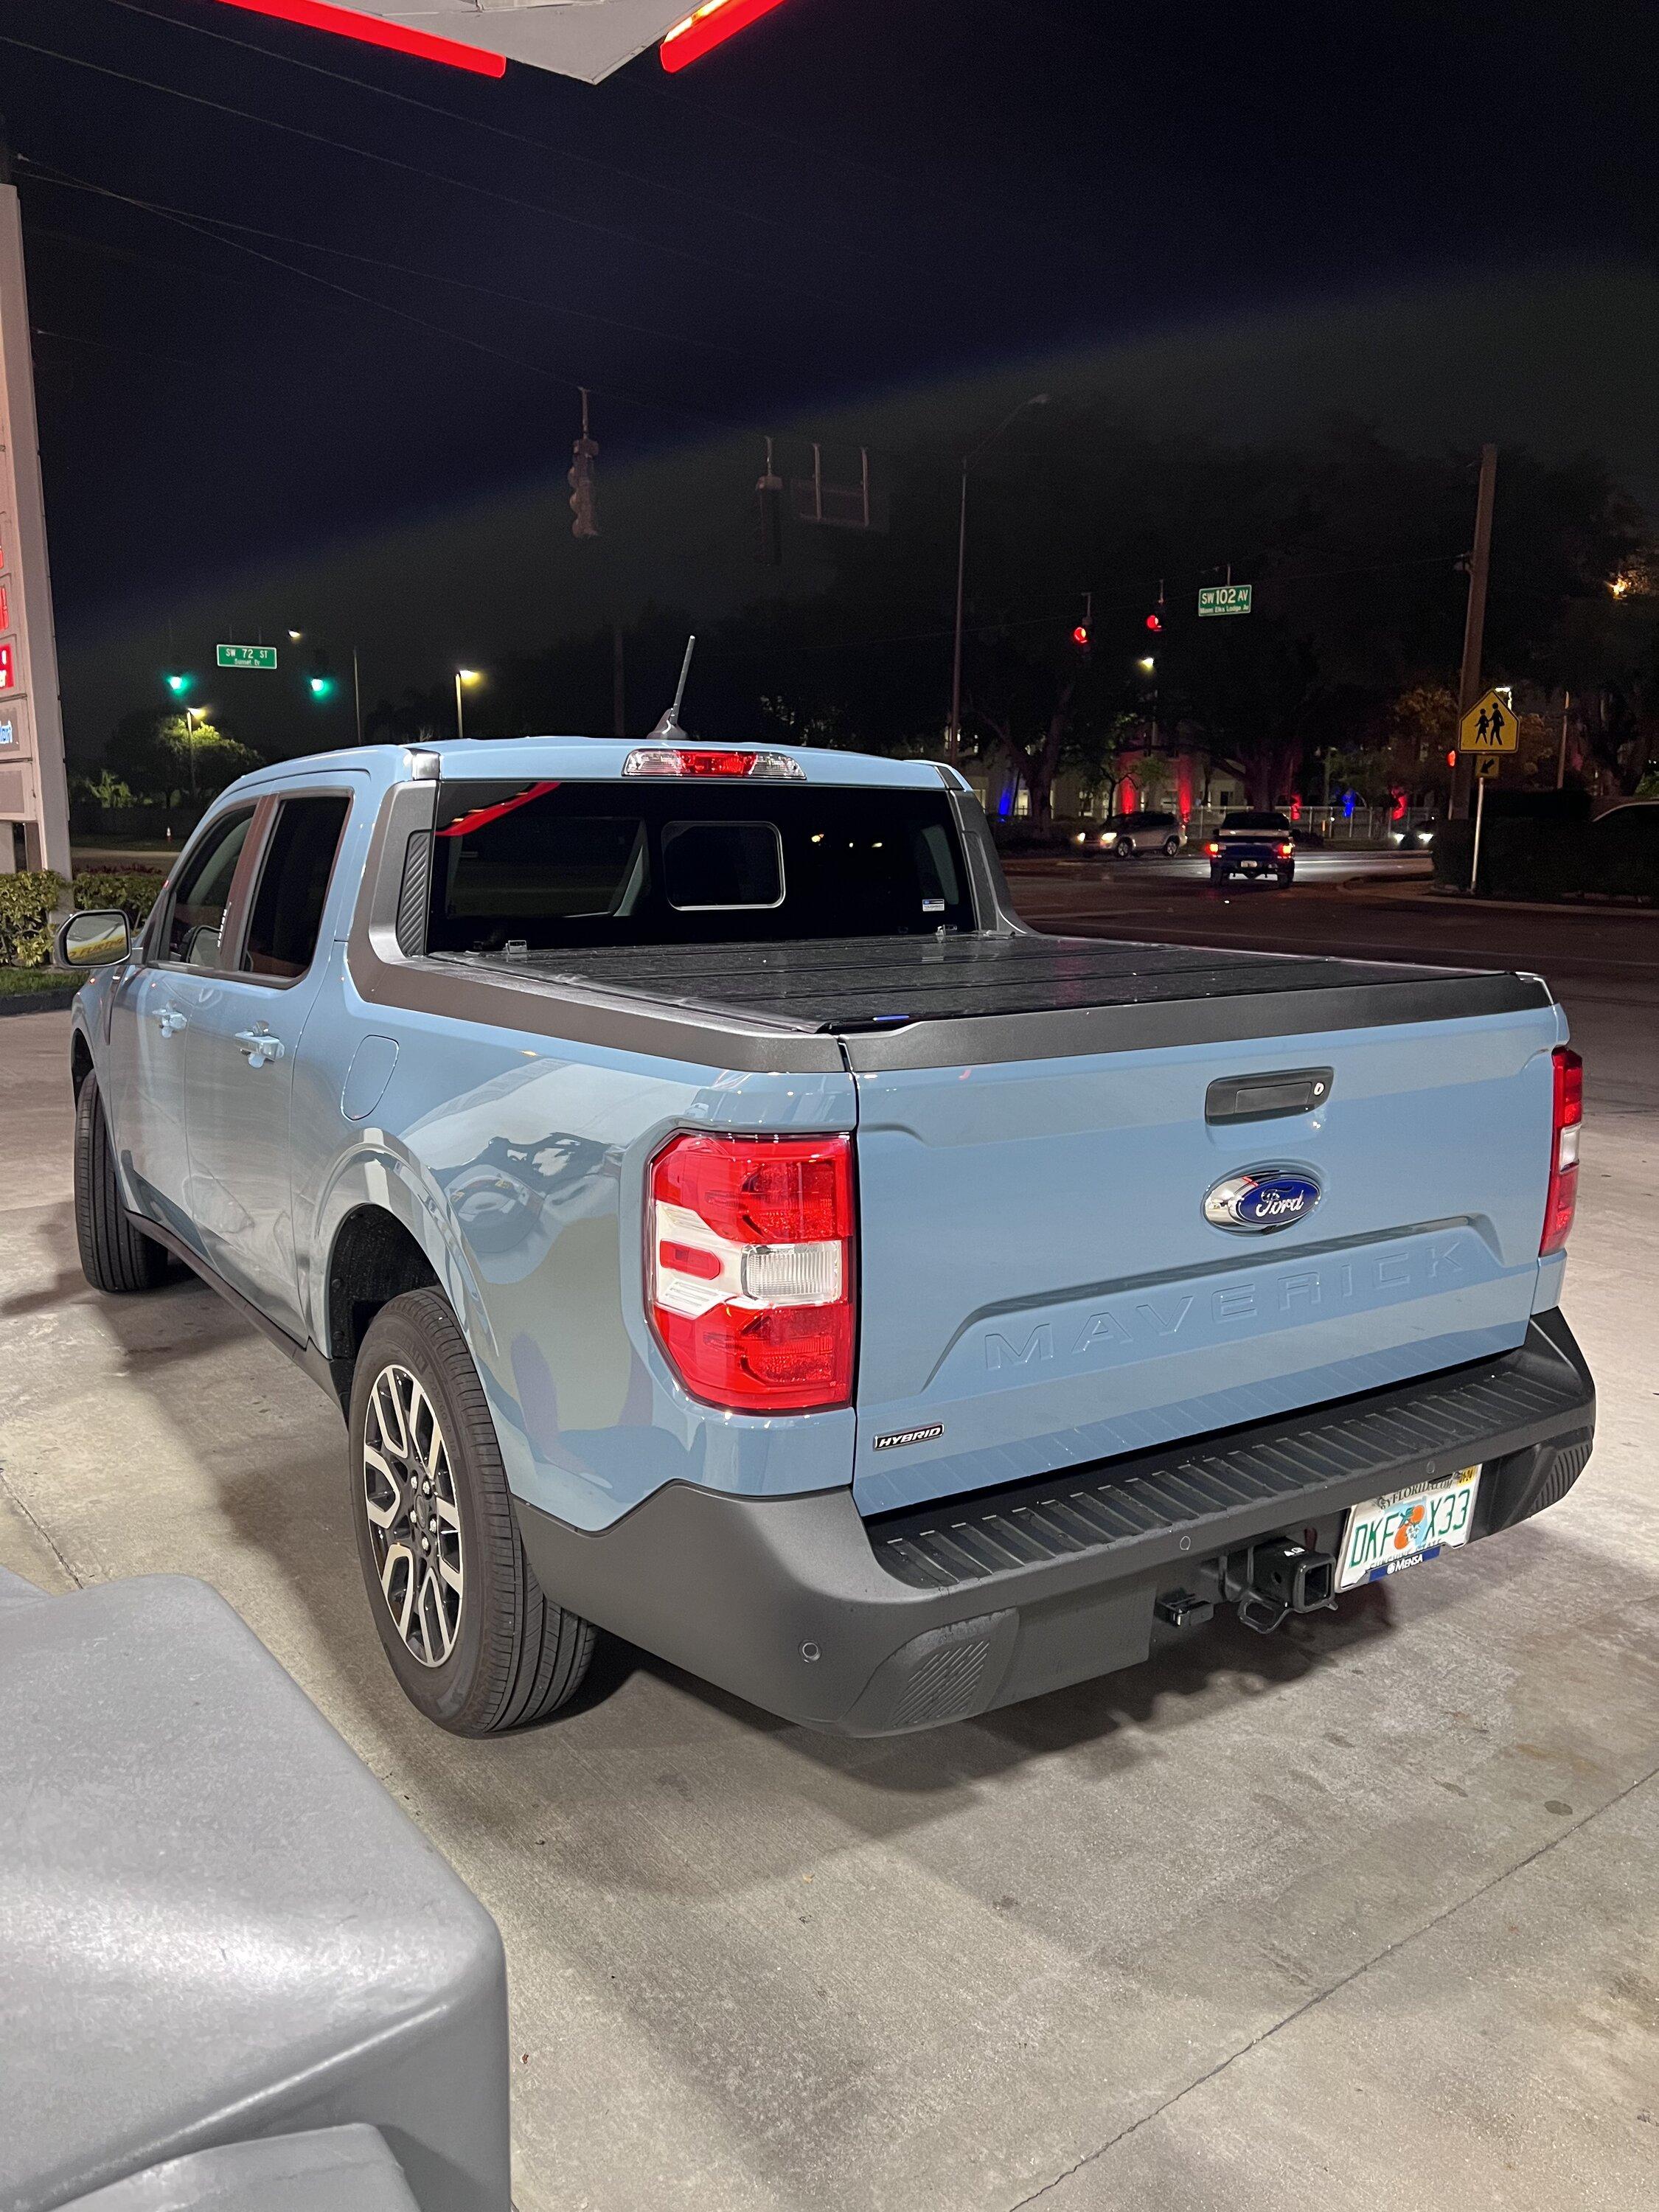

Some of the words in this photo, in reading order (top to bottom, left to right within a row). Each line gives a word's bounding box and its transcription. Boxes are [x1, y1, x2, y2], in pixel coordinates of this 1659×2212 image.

[1201, 592, 1214, 605] SW
[1216, 588, 1237, 605] 102
[1238, 589, 1248, 601] AV
[226, 648, 236, 657] SW
[242, 649, 254, 658] 72
[260, 650, 268, 658] ST
[1255, 1186, 1304, 1217] Ford
[984, 1242, 1465, 1370] MAVERICK
[878, 1427, 942, 1447] HYBRID
[1349, 1512, 1399, 1568] DKF
[1423, 1488, 1470, 1542] X33
